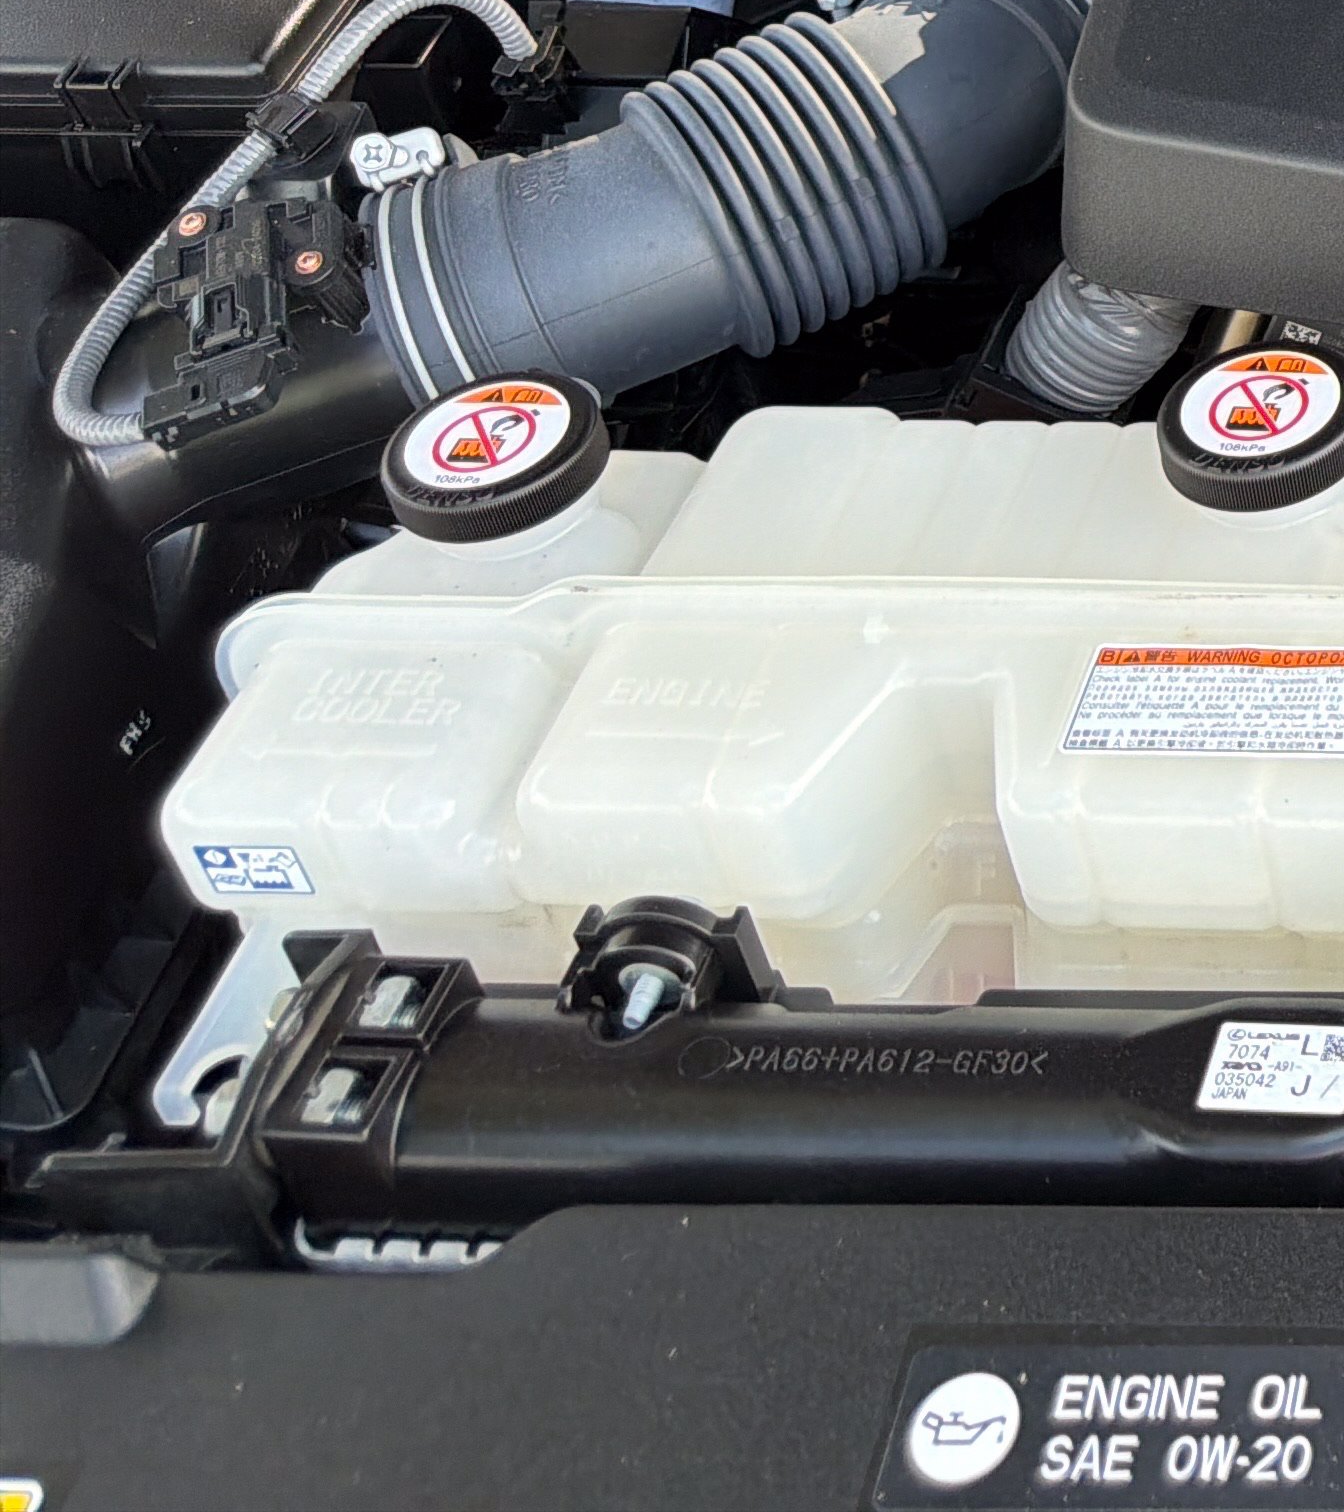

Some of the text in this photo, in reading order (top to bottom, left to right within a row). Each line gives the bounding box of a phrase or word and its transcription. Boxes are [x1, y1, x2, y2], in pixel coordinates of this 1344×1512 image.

[1219, 441, 1267, 453] 108kPa
[433, 473, 481, 485] 108kPa
[1100, 651, 1115, 663] B
[1187, 651, 1262, 663] WARNING
[1228, 1044, 1271, 1061] 7074
[1301, 1034, 1319, 1056] L
[1214, 1072, 1277, 1088] 035042
[1290, 1074, 1312, 1097] J
[1211, 1087, 1249, 1100] JAPAN
[1050, 1374, 1324, 1423] ENGINE OIL
[1038, 1433, 1315, 1483] SAE 0W-20
